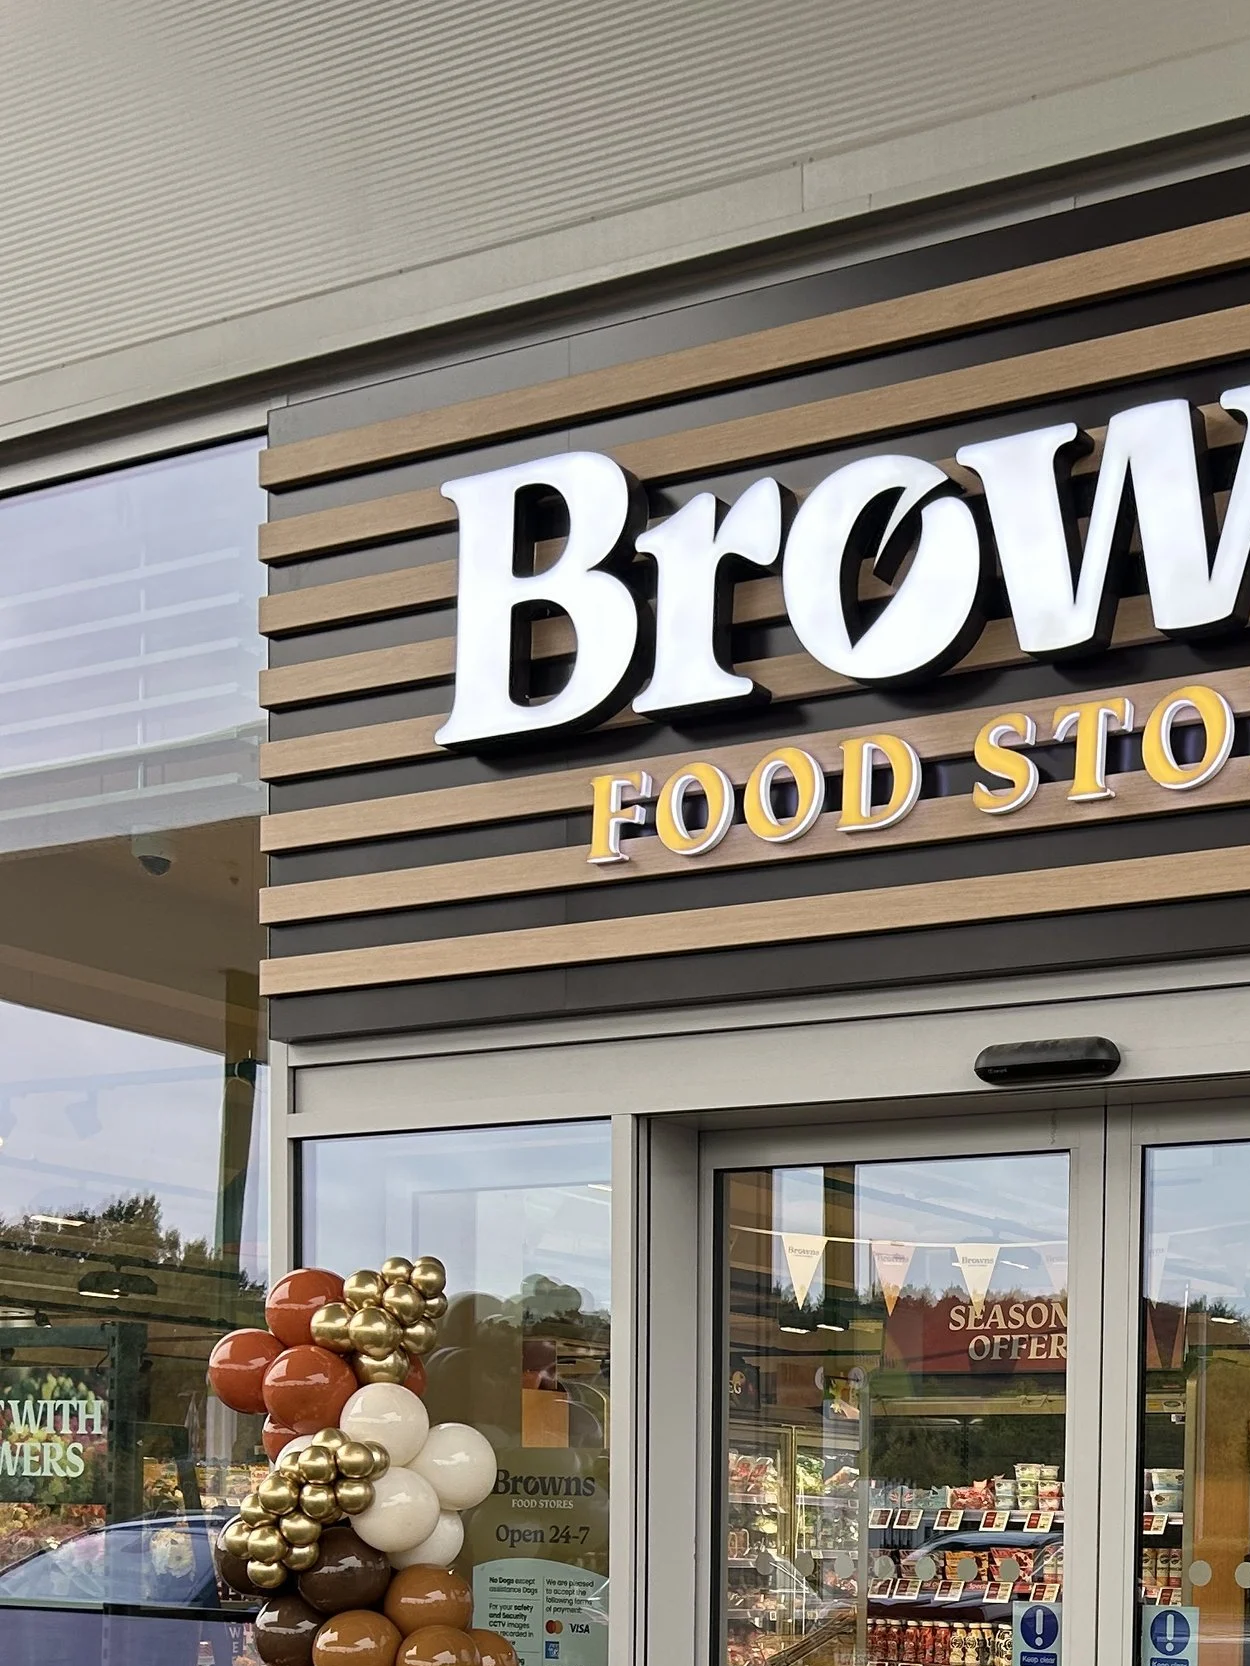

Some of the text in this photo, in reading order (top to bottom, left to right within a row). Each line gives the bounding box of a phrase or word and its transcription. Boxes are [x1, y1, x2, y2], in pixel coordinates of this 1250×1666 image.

[586, 733, 923, 864] FOOD
[8, 1399, 103, 1435] WITH
[490, 1468, 596, 1497] Browns
[511, 1498, 574, 1509] FOOD STORES
[495, 1524, 591, 1549] Open 24-7
[489, 1576, 536, 1586] No Dogs except
[553, 1589, 576, 1597] accept
[545, 1596, 574, 1606] following
[488, 1602, 534, 1613] For your safety
[545, 1605, 552, 1613] of
[488, 1611, 528, 1622] and Security
[507, 1622, 530, 1631] images
[569, 1623, 591, 1634] VISA
[1021, 1655, 1056, 1665] Keep clear
